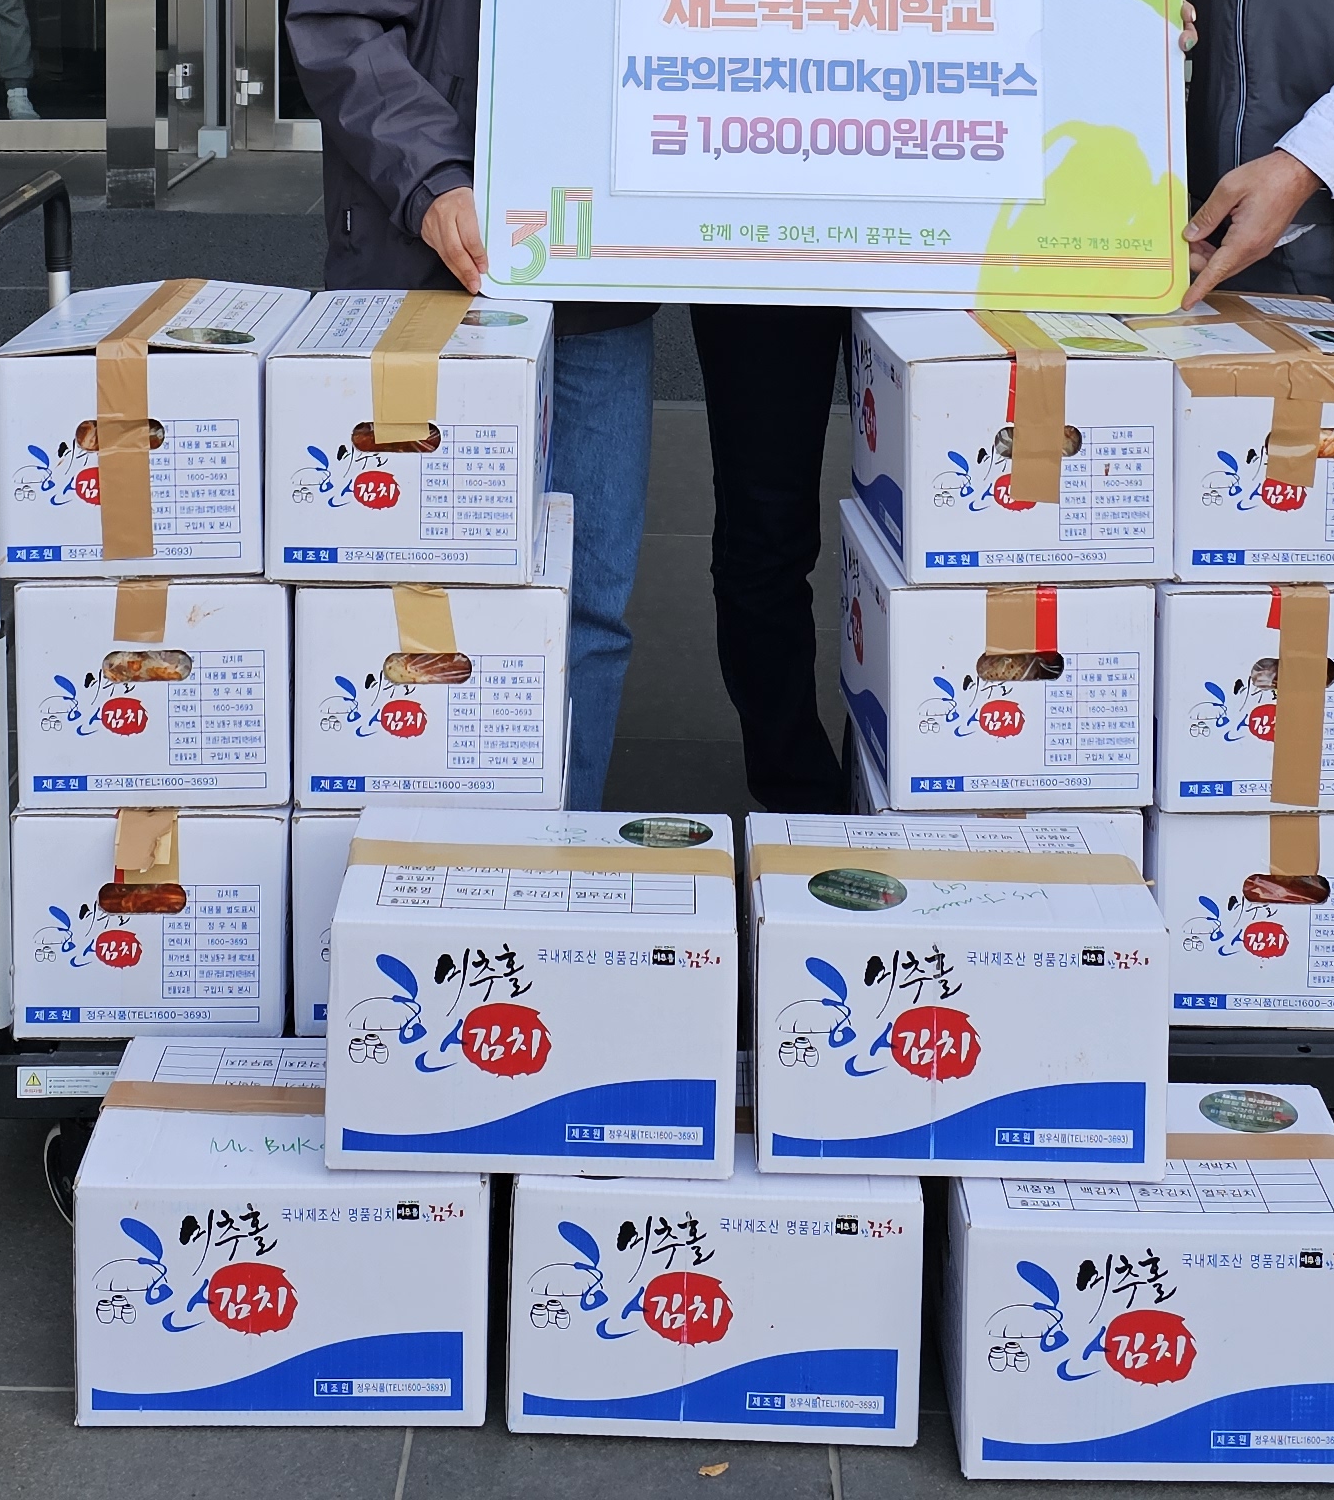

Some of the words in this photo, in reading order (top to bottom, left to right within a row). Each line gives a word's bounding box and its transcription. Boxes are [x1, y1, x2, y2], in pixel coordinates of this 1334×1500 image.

[622, 55, 1038, 101] 사랑의김치(10kg)15박스
[650, 114, 688, 155] 금
[697, 116, 1009, 162] 1,080,000원상당
[699, 223, 732, 242] 함께
[739, 224, 771, 243] 이룬
[777, 225, 820, 244] 30년,
[827, 226, 859, 244] 다시
[866, 227, 913, 246] 꿈꾸는
[919, 228, 952, 246] 연수
[1037, 236, 1082, 250] 연수구청
[1087, 238, 1109, 251] 개청
[1114, 238, 1153, 252] 30주년
[16, 549, 54, 560] 제조원
[292, 550, 329, 561] 제조원
[344, 550, 469, 562] 정우식품(TEL:1600-3693)
[934, 554, 971, 565] 제조원
[985, 551, 1107, 563] 정우식품(TEL:1600-3693)
[1200, 552, 1237, 563] 제조원
[42, 777, 79, 789] 제조원
[94, 776, 218, 788] 정우식품(TEL:1600-3693)
[320, 779, 357, 790] 제조원
[371, 779, 495, 791] 정우식품(TEL:1600-3693)
[918, 779, 956, 790] 제조원
[970, 777, 1092, 788] 정우식품(TEL:1600-3693)
[1188, 783, 1225, 794] 제조원
[537, 949, 597, 964] 국내제조산
[604, 949, 651, 966] 명품김치
[966, 951, 1026, 966] 국내제조산
[1033, 952, 1081, 968] 명품김치
[434, 943, 533, 1016] 미추홀
[864, 944, 963, 1019] 미추홀
[1181, 996, 1218, 1007] 제조원
[34, 1009, 72, 1021] 제조원
[86, 1009, 211, 1021] 정우식품(TEL:1600-3693)
[468, 1025, 550, 1063] 김치
[897, 1029, 980, 1064] 김치
[571, 1127, 601, 1140] 제조원
[1000, 1131, 1031, 1144] 제조원
[1080, 1185, 1121, 1196] 백김치
[281, 1206, 341, 1222] 국내제조산
[347, 1207, 396, 1223] 명품김치
[719, 1217, 779, 1234] 국내제조산
[786, 1218, 834, 1237] 명품김치
[179, 1202, 279, 1276] 미추홀
[616, 1211, 716, 1283] 미추홀
[1182, 1252, 1243, 1268] 국내제조산
[1249, 1253, 1298, 1269] 명품김치
[1076, 1247, 1178, 1324] 미추홀
[215, 1285, 297, 1320] 김치
[649, 1294, 733, 1329] 김치
[1112, 1333, 1197, 1370] 김치
[320, 1382, 350, 1394] 제조원
[751, 1395, 782, 1407] 제조원
[1216, 1434, 1247, 1447] 제조원
